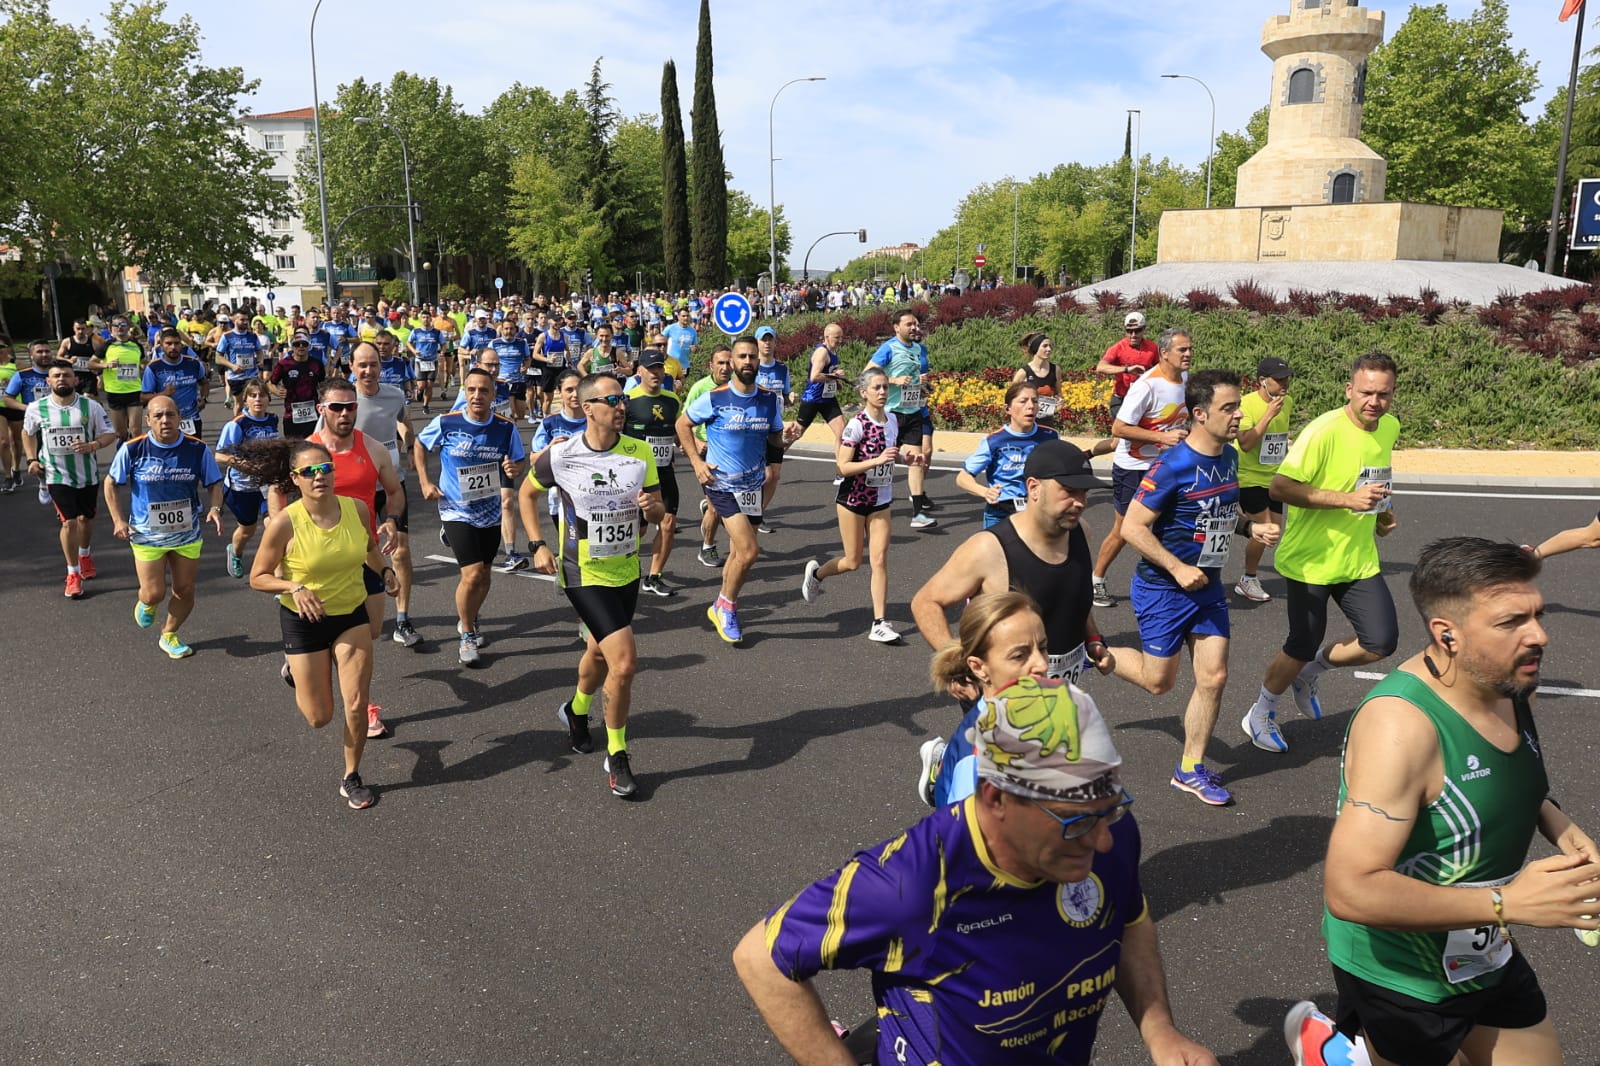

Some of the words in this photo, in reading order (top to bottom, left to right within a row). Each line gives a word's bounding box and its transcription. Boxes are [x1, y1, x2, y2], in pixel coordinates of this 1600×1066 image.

[456, 440, 473, 449] XII
[1267, 442, 1283, 455] 967
[652, 446, 670, 458] 909
[146, 464, 163, 473] XII
[468, 473, 491, 490] 221
[741, 492, 757, 506] 390
[158, 511, 184, 525] 908
[591, 512, 603, 522] XII
[595, 523, 633, 543] 1354
[1210, 534, 1231, 552] 129
[1461, 767, 1492, 782] VIATOR
[956, 913, 1013, 934] MAGLIA
[977, 981, 1035, 1007] Jamón
[1000, 1027, 1047, 1048] Atletismo
